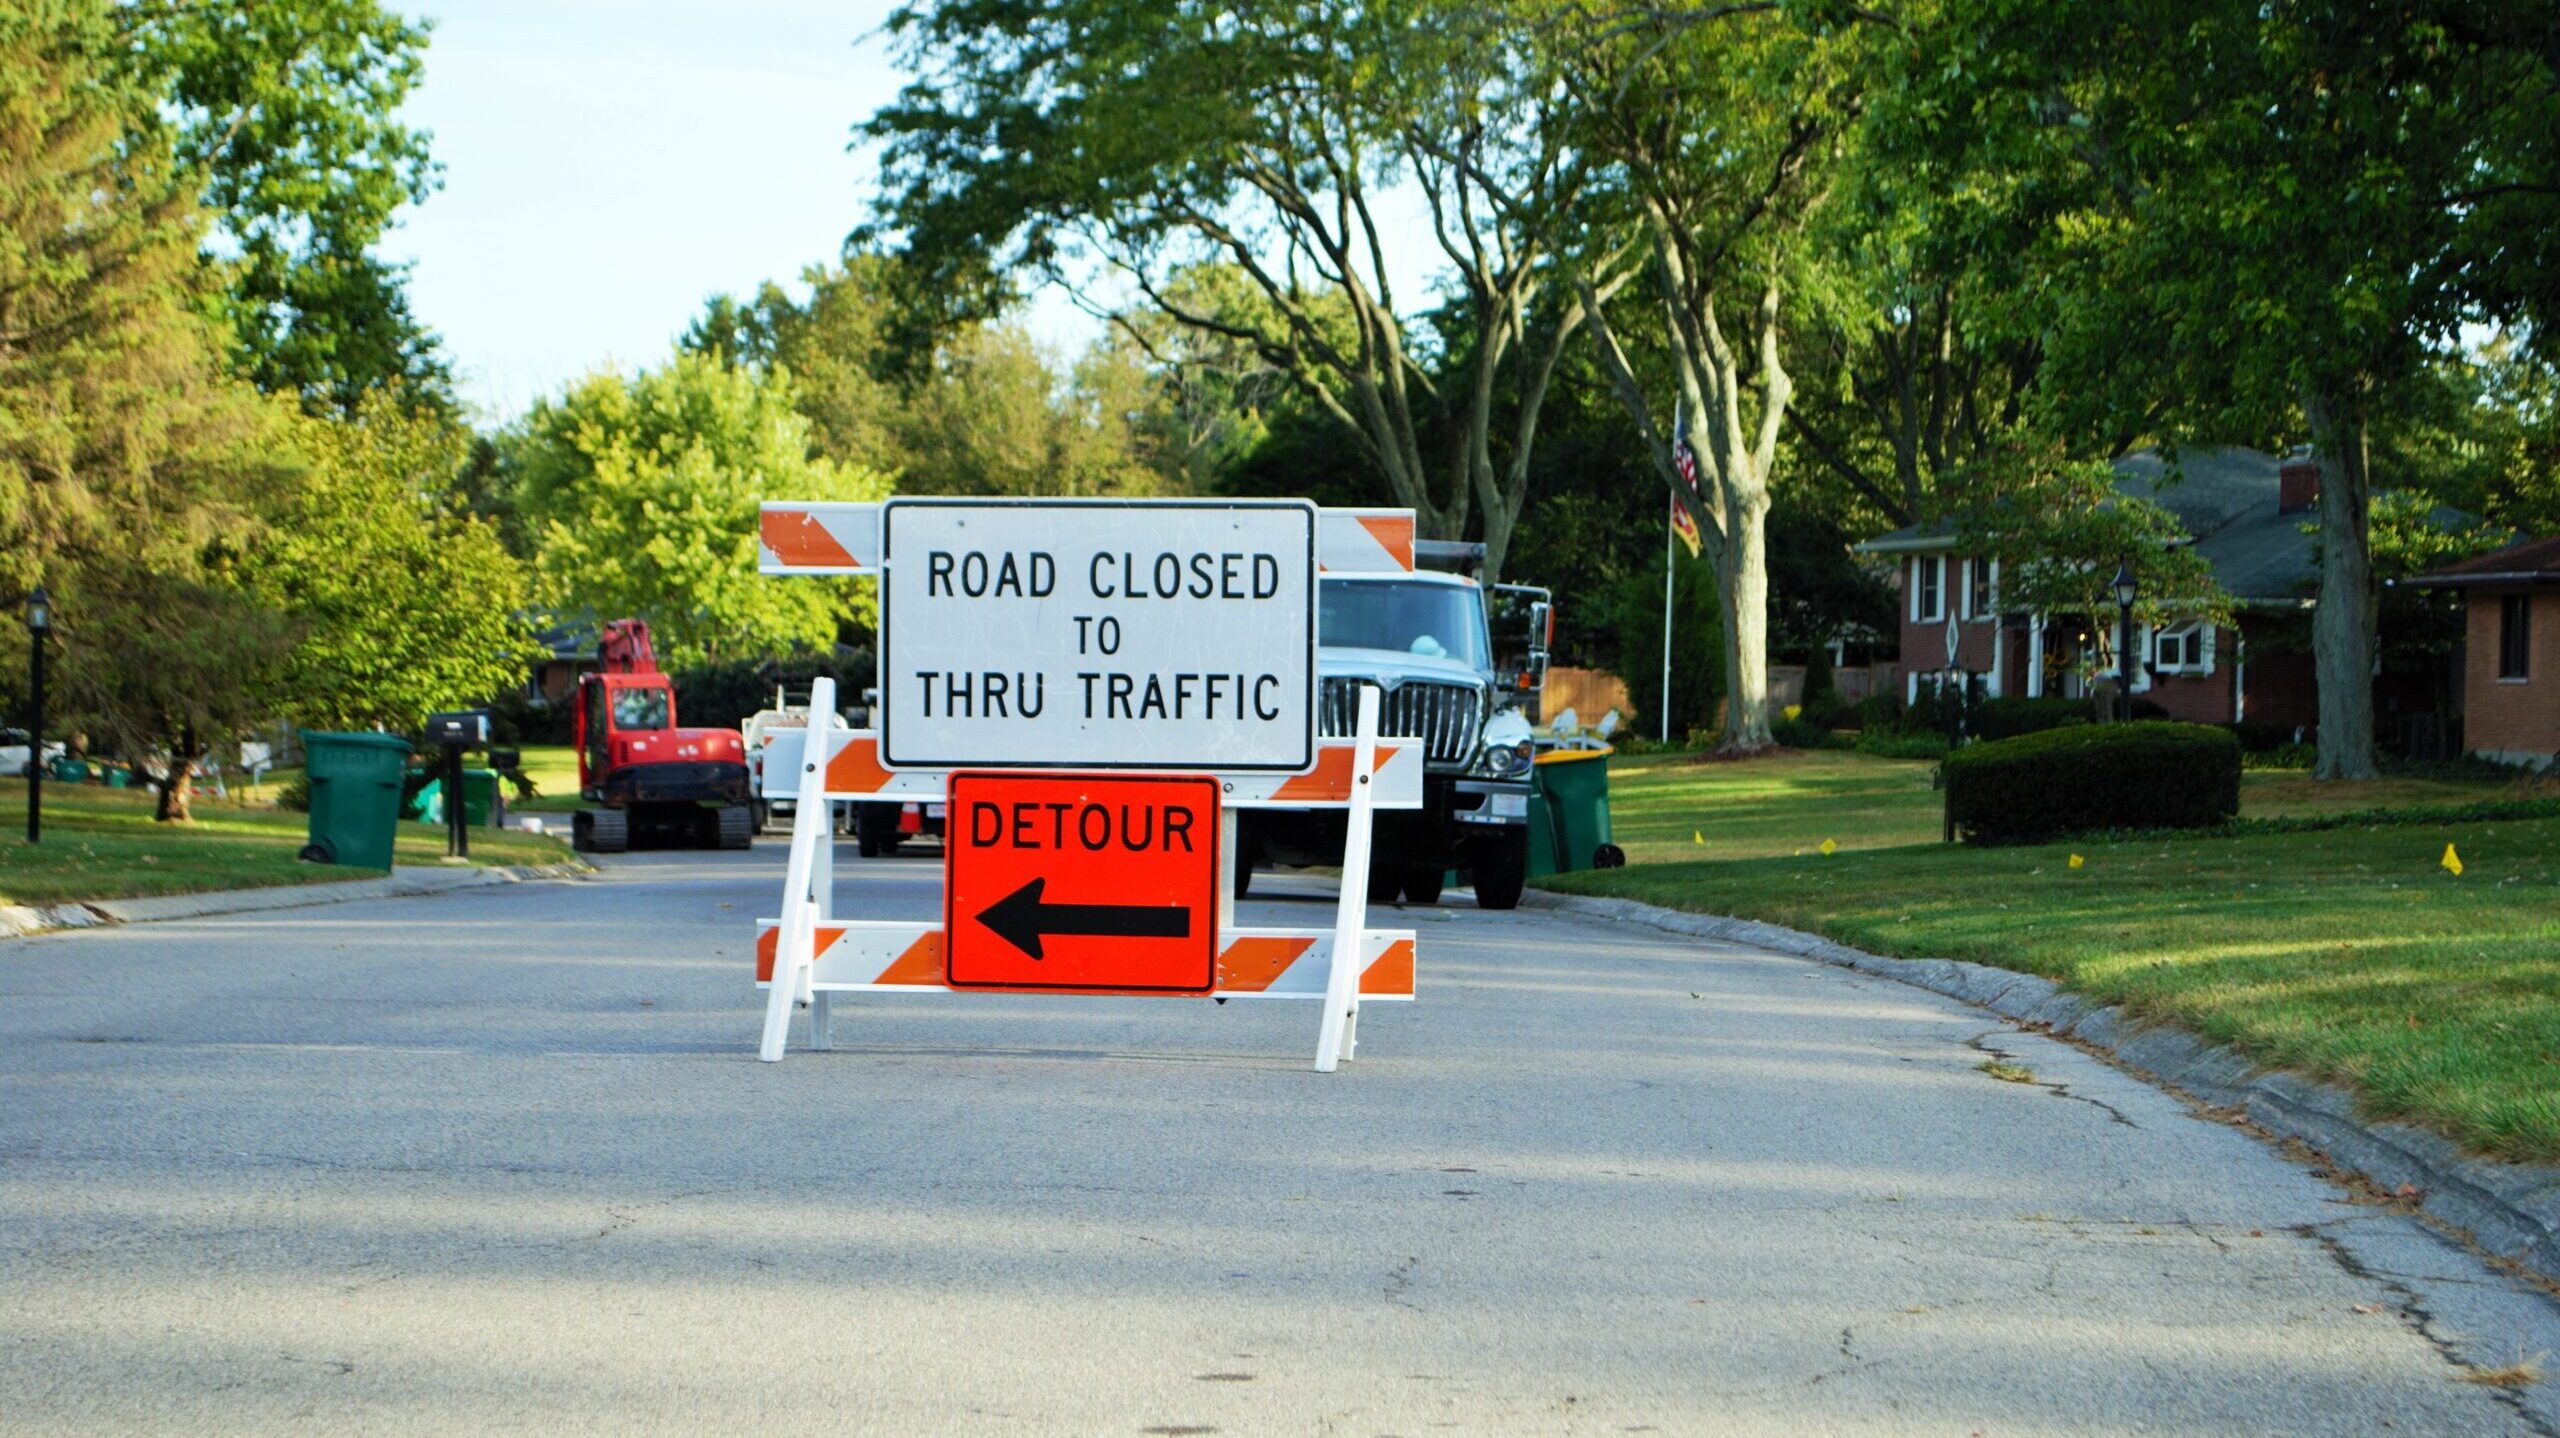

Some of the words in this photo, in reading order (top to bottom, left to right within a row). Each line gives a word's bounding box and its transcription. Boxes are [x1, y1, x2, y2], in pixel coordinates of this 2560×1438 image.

[929, 551, 1056, 598] ROAD
[1090, 551, 1279, 600] CLOSED
[1073, 616, 1121, 655] TO
[915, 672, 1043, 718] THRU
[1076, 672, 1280, 721] TRAFFIC
[972, 802, 1194, 852] DETOUR
